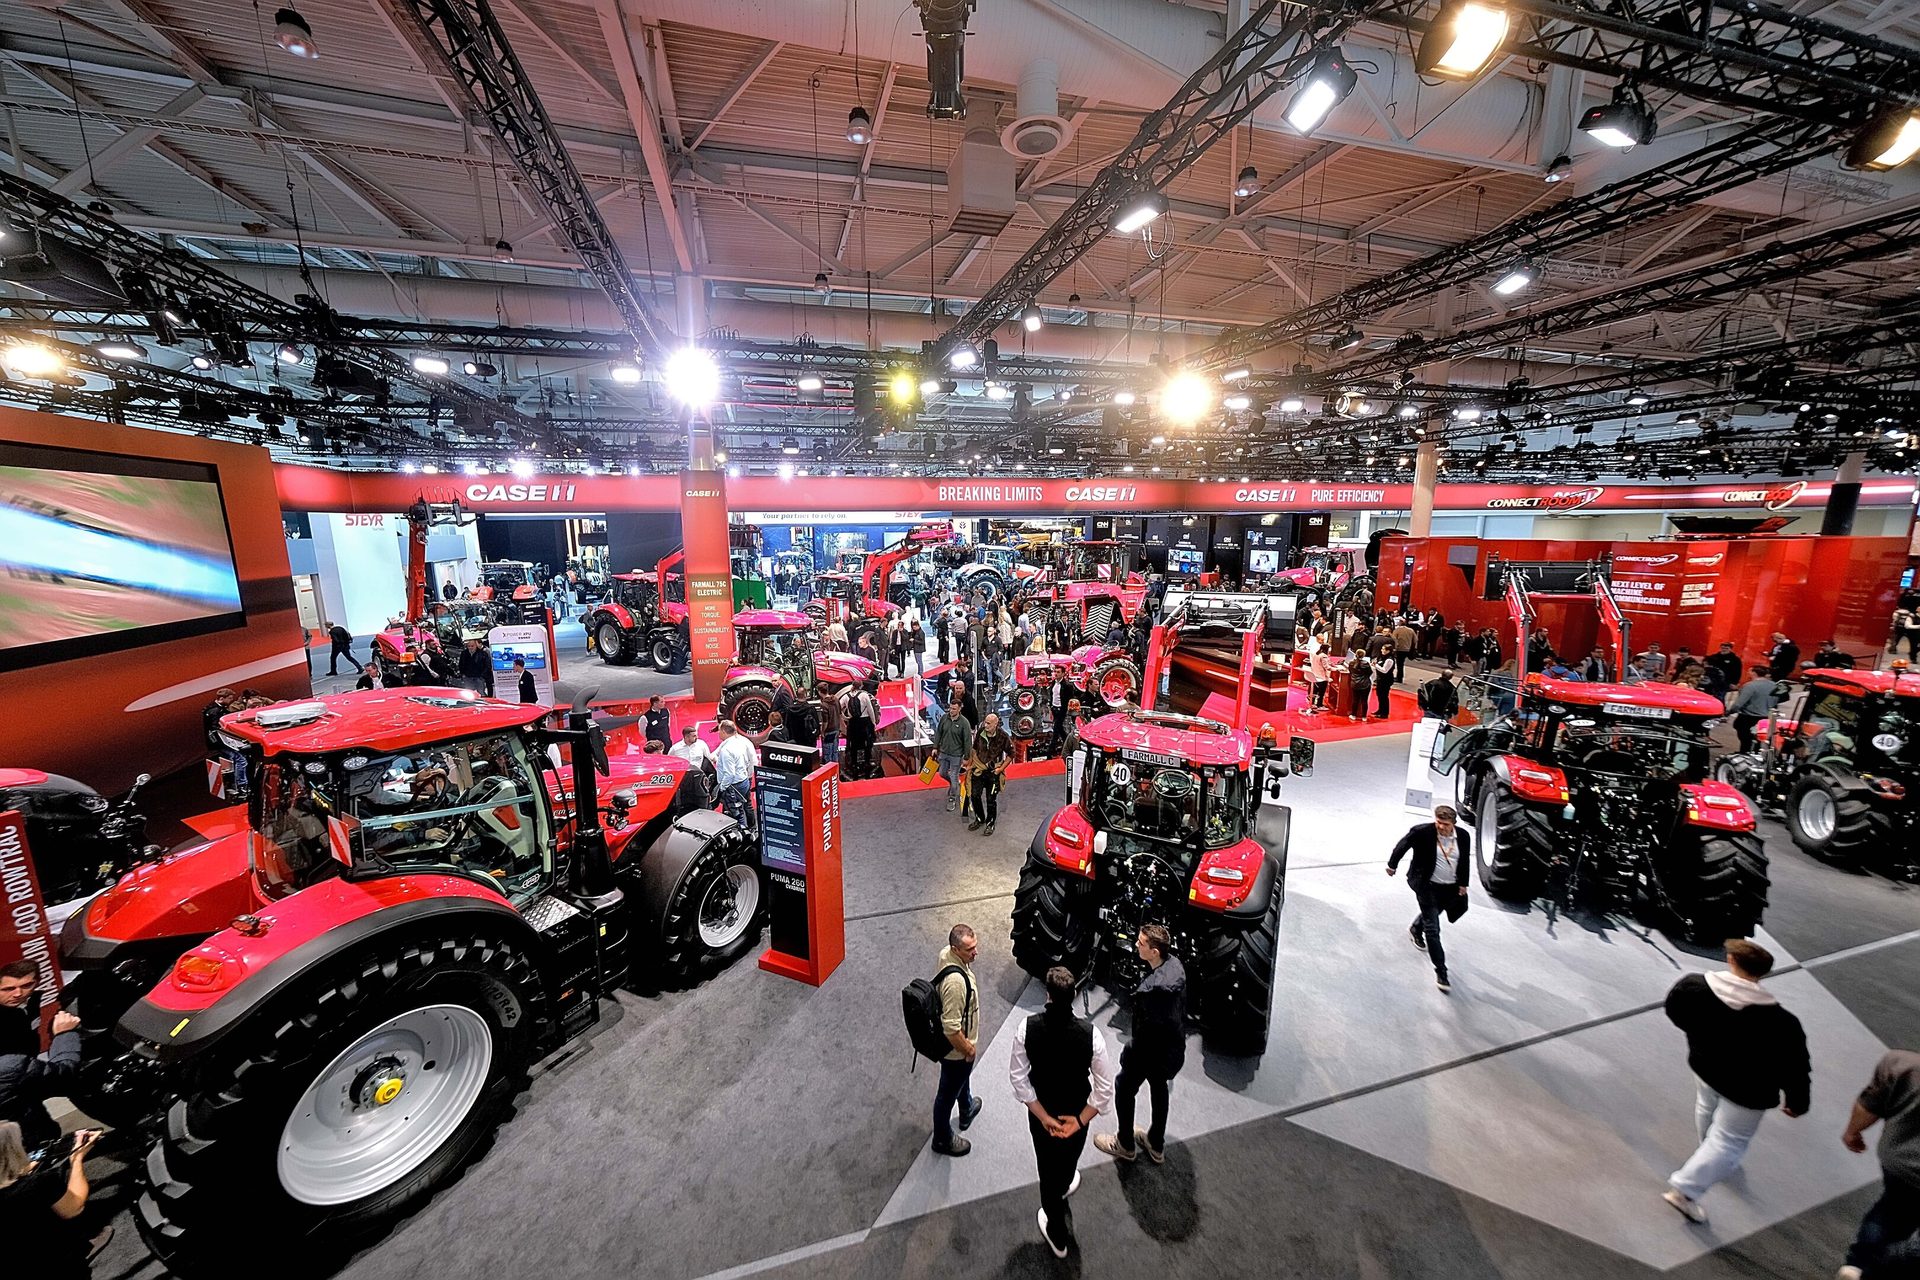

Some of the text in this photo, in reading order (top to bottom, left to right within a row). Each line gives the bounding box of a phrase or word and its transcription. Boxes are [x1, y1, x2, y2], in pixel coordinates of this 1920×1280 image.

[466, 484, 548, 502] CASE
[939, 486, 1043, 501] BREAKING LIMITS
[1065, 487, 1117, 502] CASE
[1235, 489, 1281, 502] CASE
[1311, 489, 1385, 503] PURE EFFICIENCY
[345, 514, 384, 527] STEYR
[1611, 704, 1664, 717] FARMALL A
[1876, 737, 1895, 748] 40
[769, 753, 794, 764] CASE
[1128, 749, 1174, 766] FARMALL C
[650, 774, 674, 786] 260
[1113, 766, 1127, 781] 40
[831, 773, 839, 818] CVXDRIVE
[821, 779, 832, 853] PUMA 260
[0, 825, 34, 904] ROWTRAC
[770, 872, 805, 888] PUMA 260
[12, 903, 42, 935] 400
